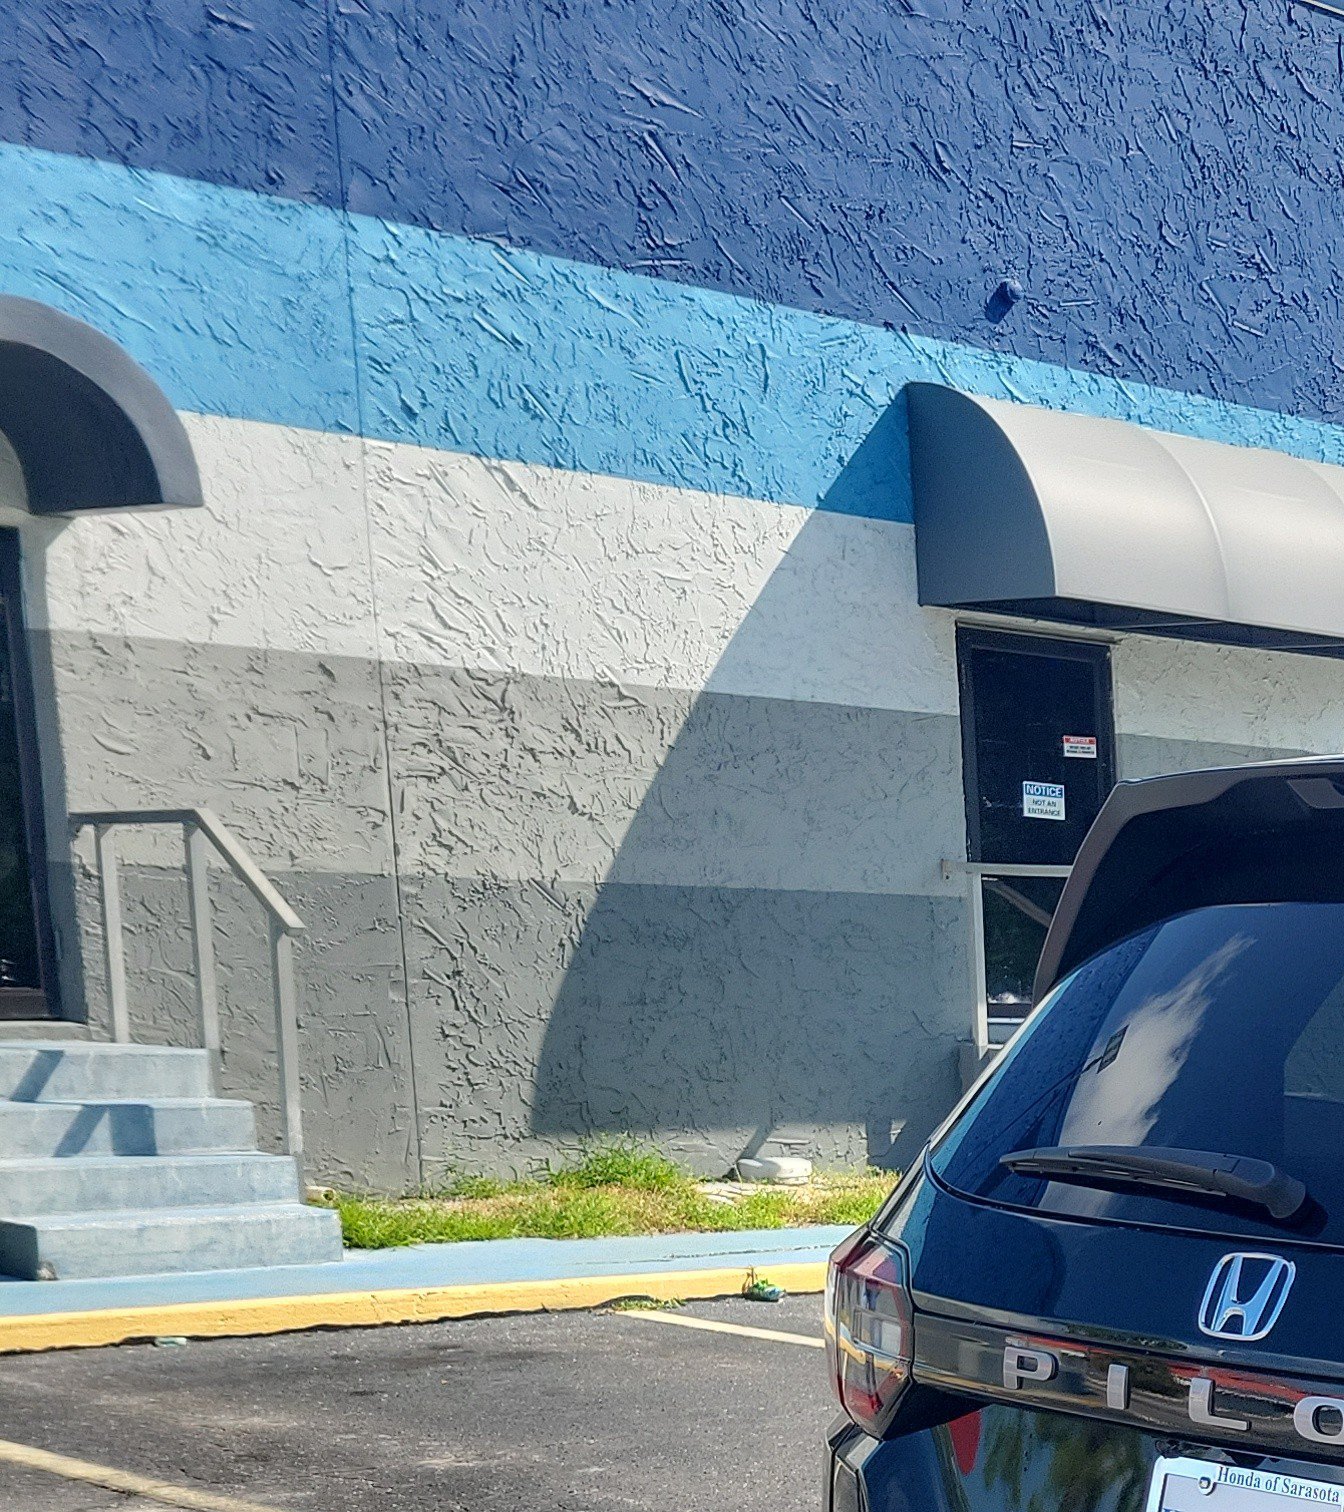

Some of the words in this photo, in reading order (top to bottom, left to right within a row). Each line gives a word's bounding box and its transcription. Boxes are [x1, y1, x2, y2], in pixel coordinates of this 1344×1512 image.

[1026, 784, 1062, 797] NOTICE
[1032, 798, 1045, 806] NOT
[1217, 1466, 1261, 1489] Honda
[1265, 1477, 1281, 1492] of
[1281, 1477, 1340, 1503] Sarasota
